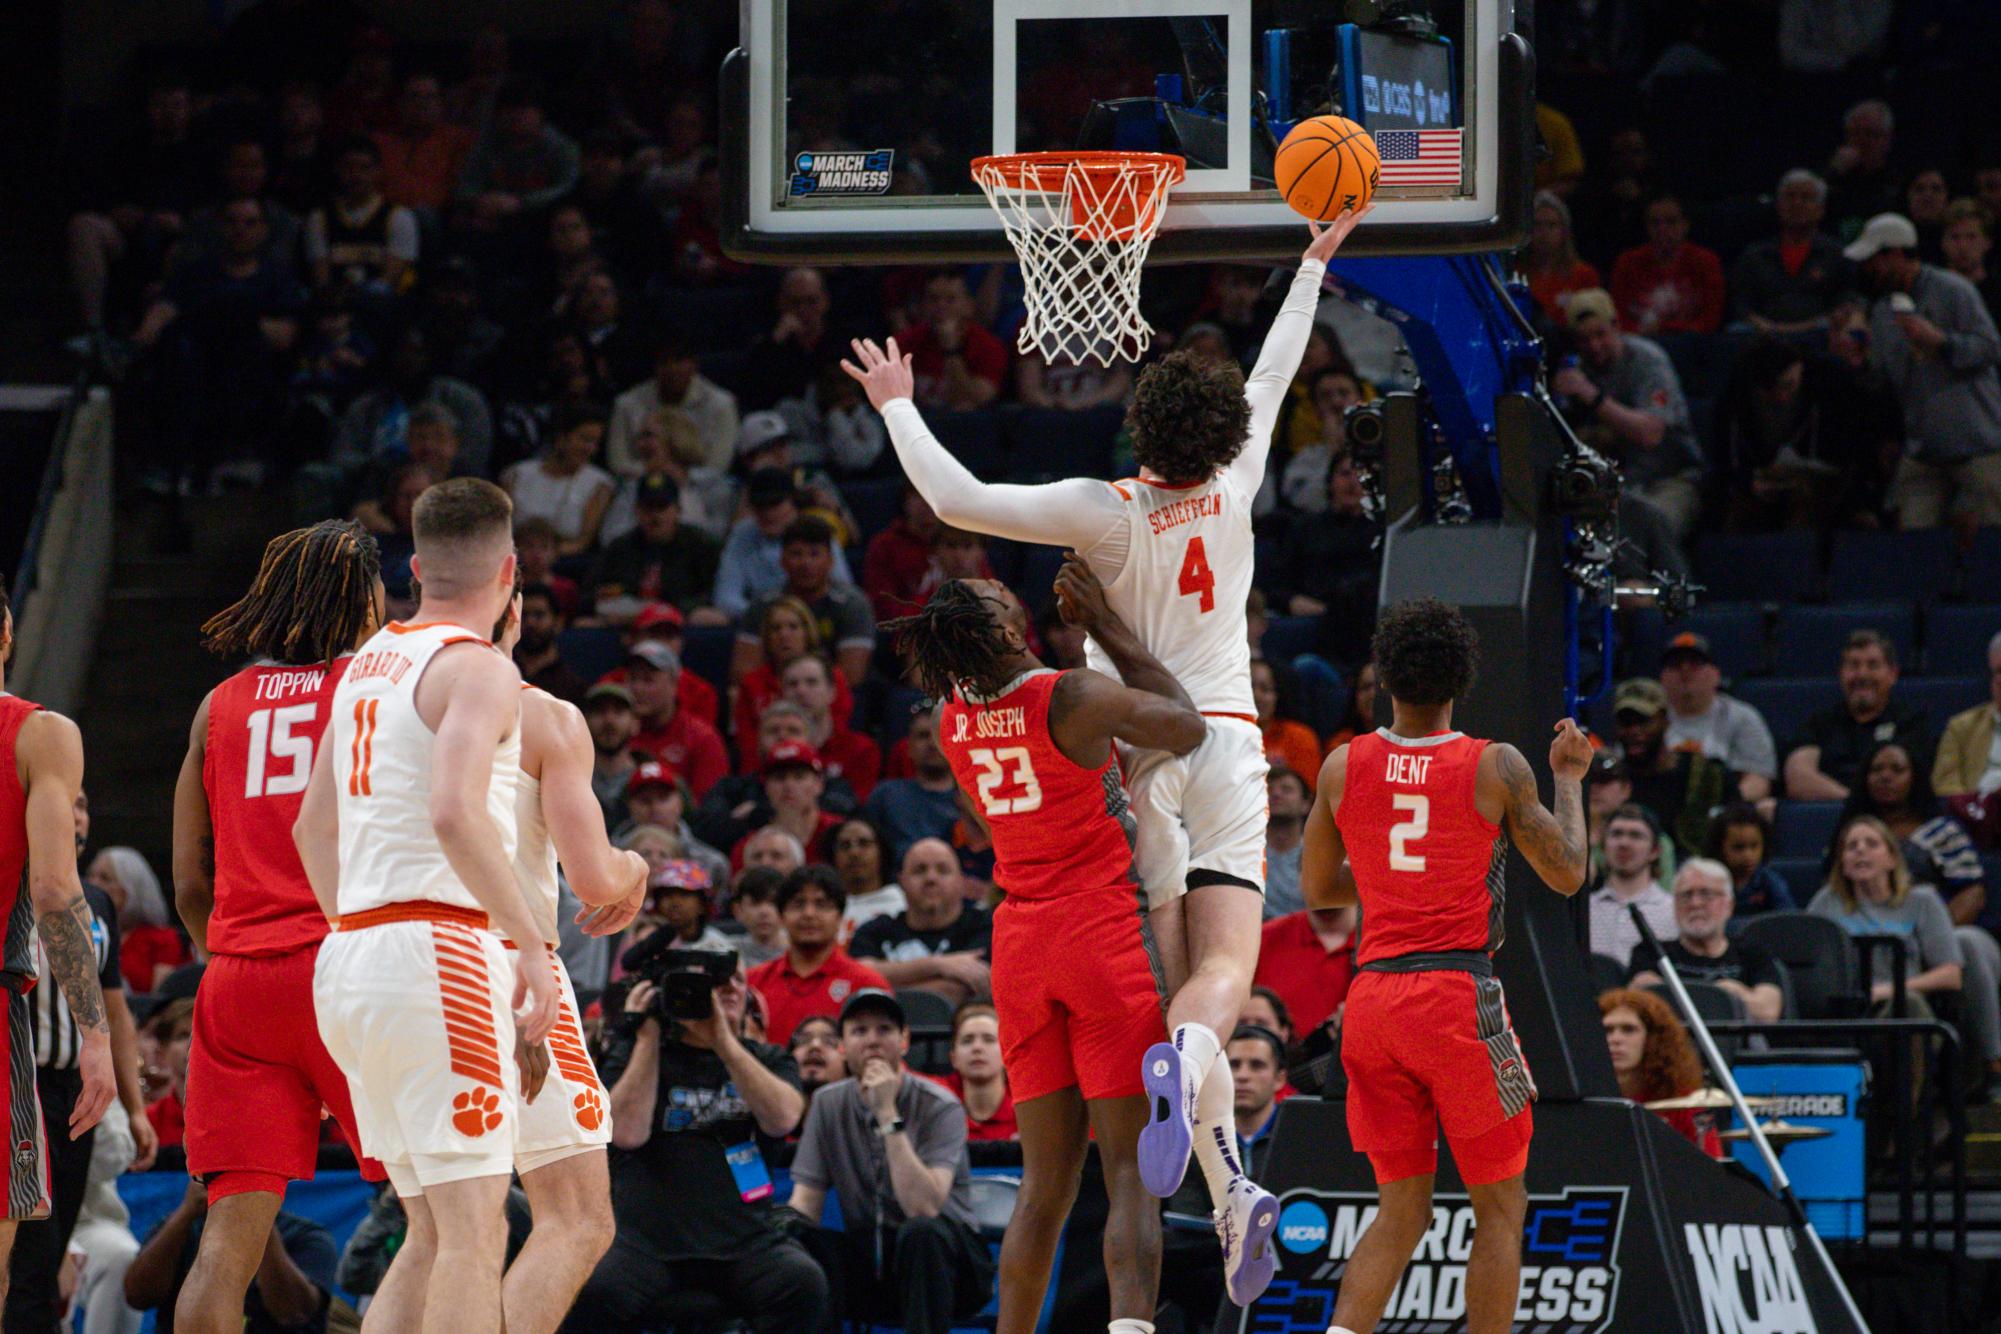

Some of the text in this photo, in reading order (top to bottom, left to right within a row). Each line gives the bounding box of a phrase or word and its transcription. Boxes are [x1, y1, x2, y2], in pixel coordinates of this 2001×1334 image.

[813, 155, 865, 172] MARCH
[818, 171, 888, 188] MADNESS
[1178, 536, 1215, 614] 4
[255, 670, 325, 700] TOPPIN
[349, 651, 399, 682] GIRARD
[245, 702, 317, 799] 15
[350, 698, 379, 796] 11
[952, 706, 1026, 743] JR. JOSEPH
[968, 746, 1043, 815] 23
[1385, 753, 1433, 785] DENT
[1389, 793, 1430, 872] 2
[1283, 1226, 1327, 1241] NCAA
[1328, 1205, 1476, 1262] MRC
[1384, 1264, 1607, 1322] ADESS
[1683, 1222, 1820, 1334] NCAA
